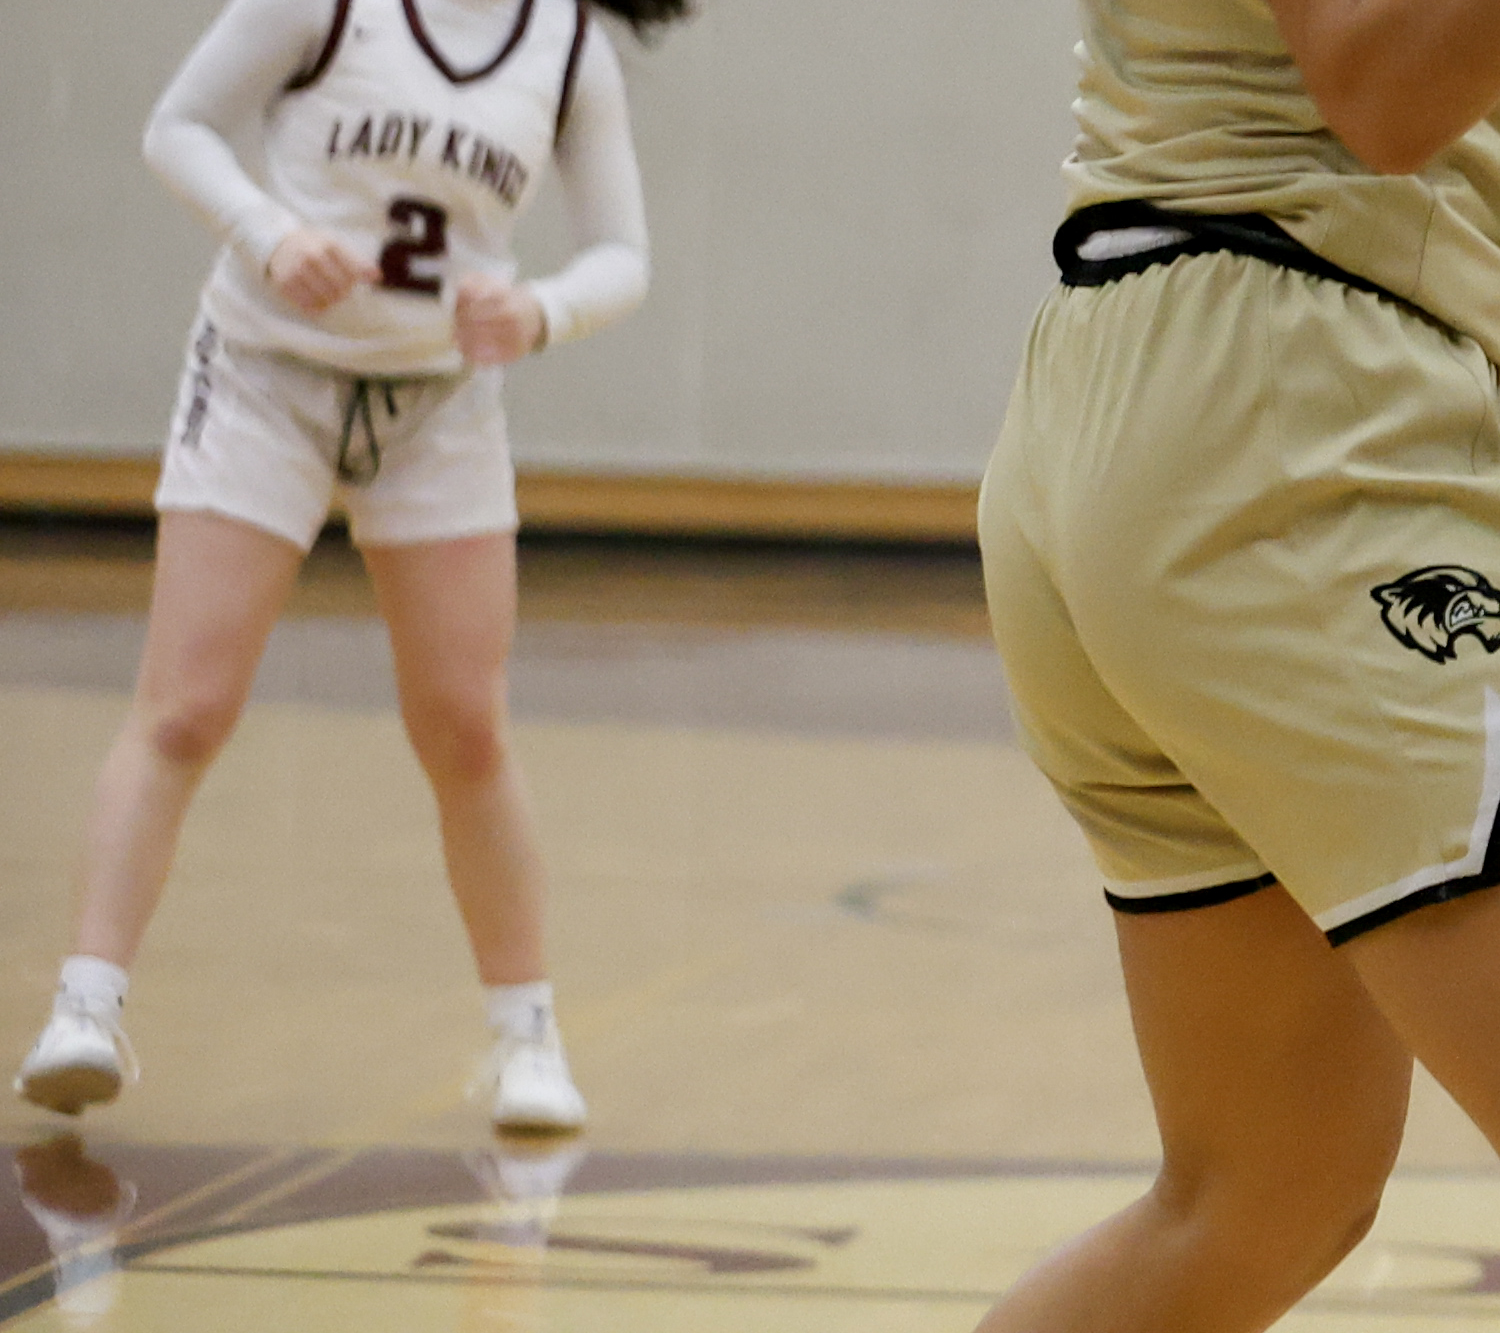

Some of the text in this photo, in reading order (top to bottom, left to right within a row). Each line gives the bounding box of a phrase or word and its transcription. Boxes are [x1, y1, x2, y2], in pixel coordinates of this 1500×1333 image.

[327, 112, 530, 208] LADY KINGS
[374, 191, 449, 299] 2
